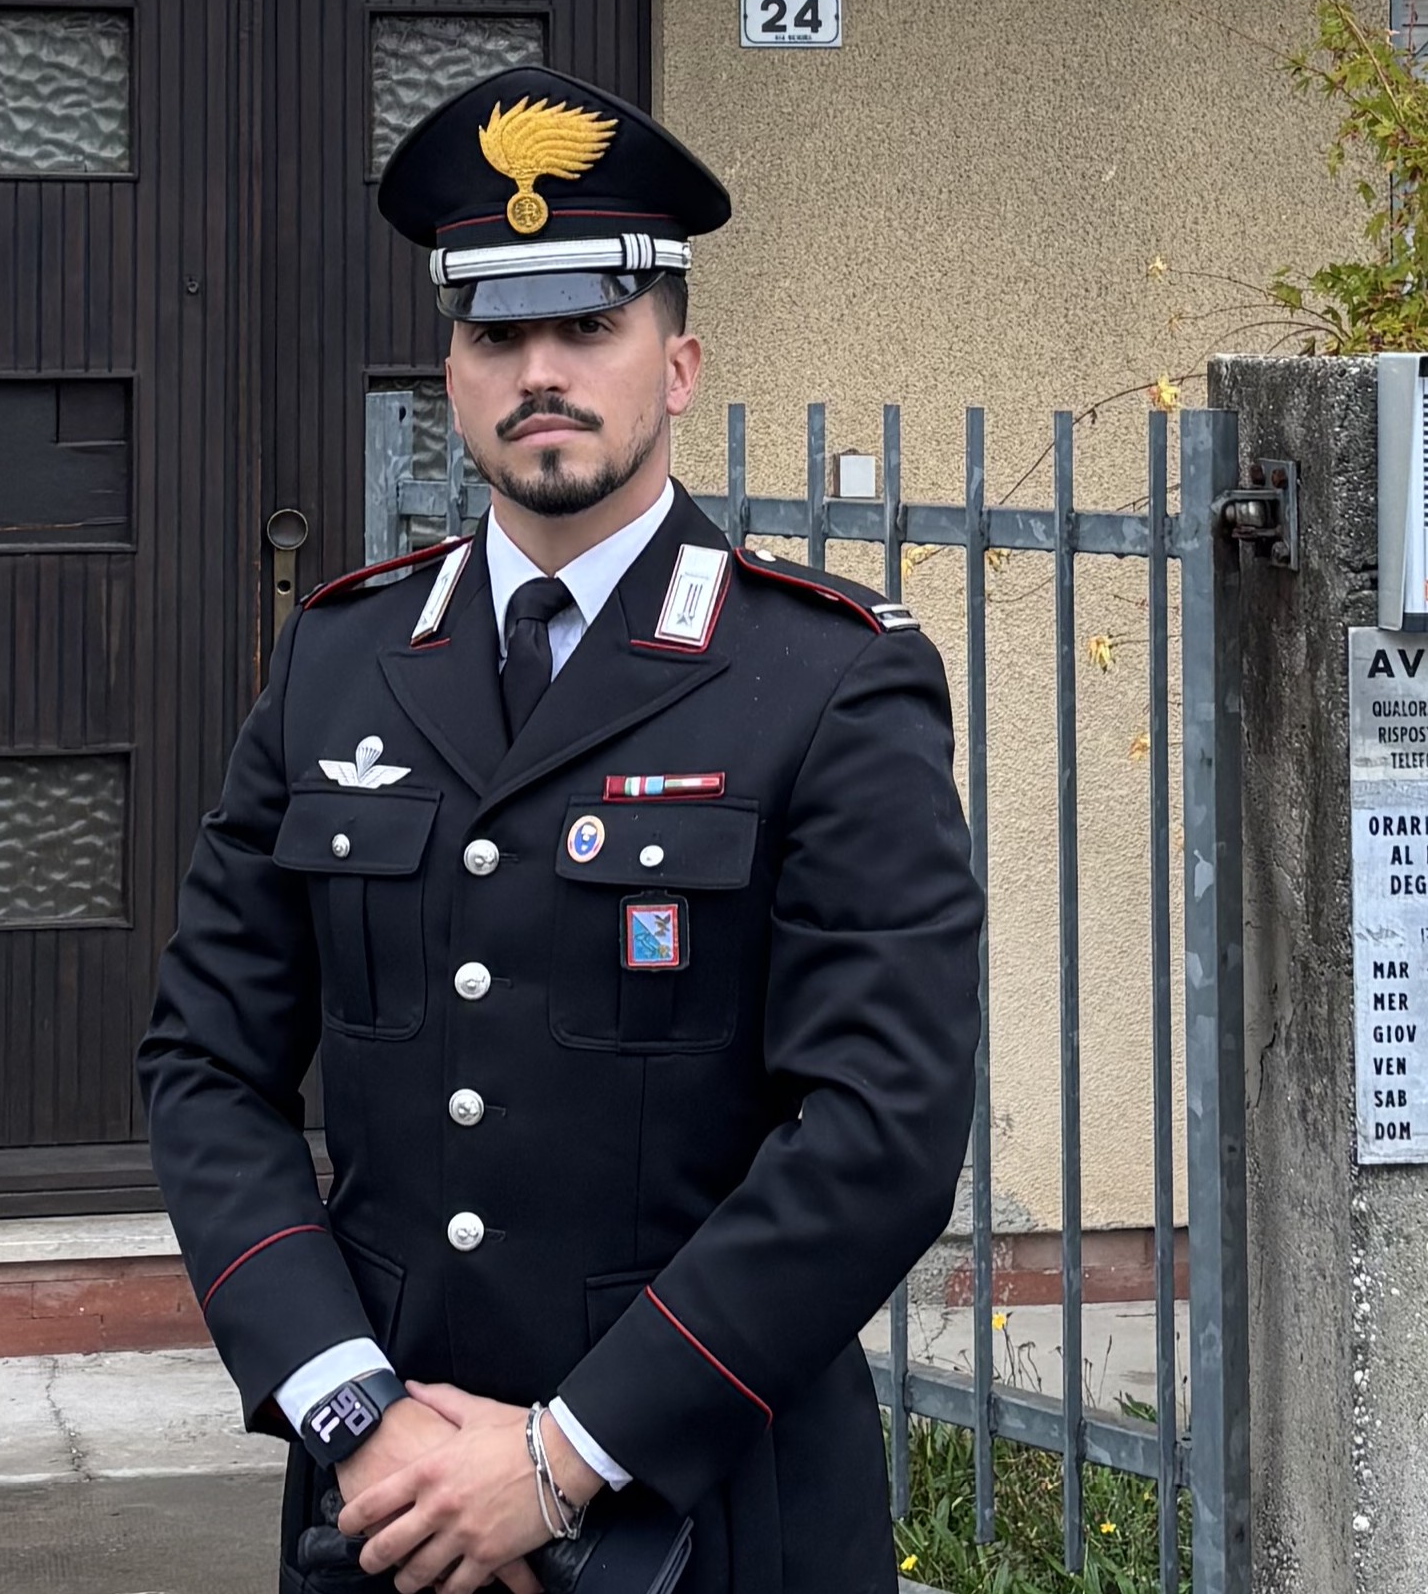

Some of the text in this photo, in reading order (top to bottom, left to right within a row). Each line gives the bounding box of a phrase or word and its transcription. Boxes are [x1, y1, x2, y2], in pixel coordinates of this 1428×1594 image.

[1390, 845, 1414, 865] AL
[1373, 961, 1409, 979] MAR
[1373, 993, 1409, 1011] MER
[1373, 1024, 1417, 1043] GIOV
[1373, 1057, 1407, 1075] VEN
[1374, 1089, 1408, 1107] SAB
[1375, 1121, 1412, 1140] DOM
